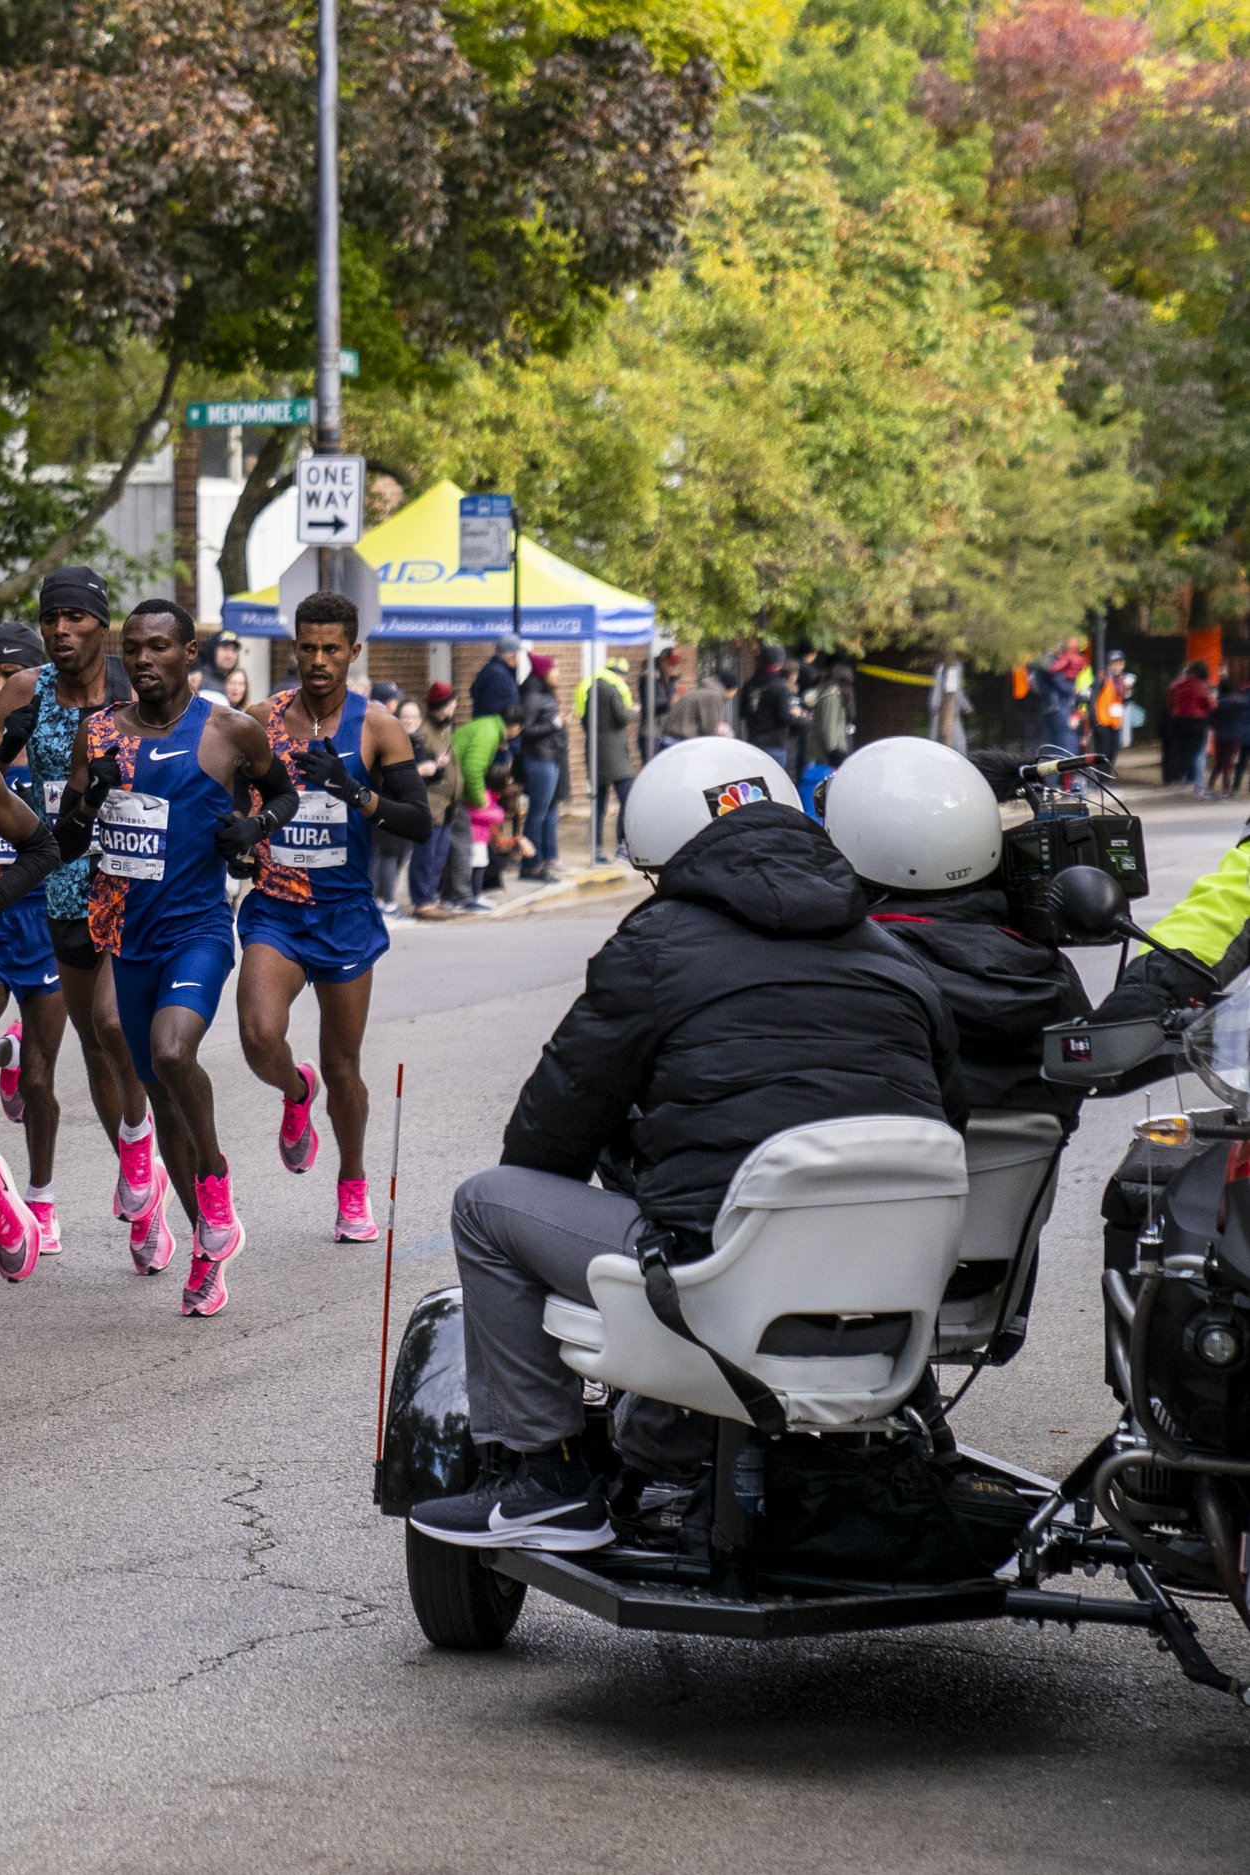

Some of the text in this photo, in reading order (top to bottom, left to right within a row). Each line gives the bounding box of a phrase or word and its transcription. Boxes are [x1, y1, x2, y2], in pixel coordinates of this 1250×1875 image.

[207, 403, 292, 423] MENOMONEE
[307, 466, 353, 485] ONE
[306, 491, 353, 508] WAY
[388, 616, 474, 633] Association
[281, 826, 332, 846] TURA
